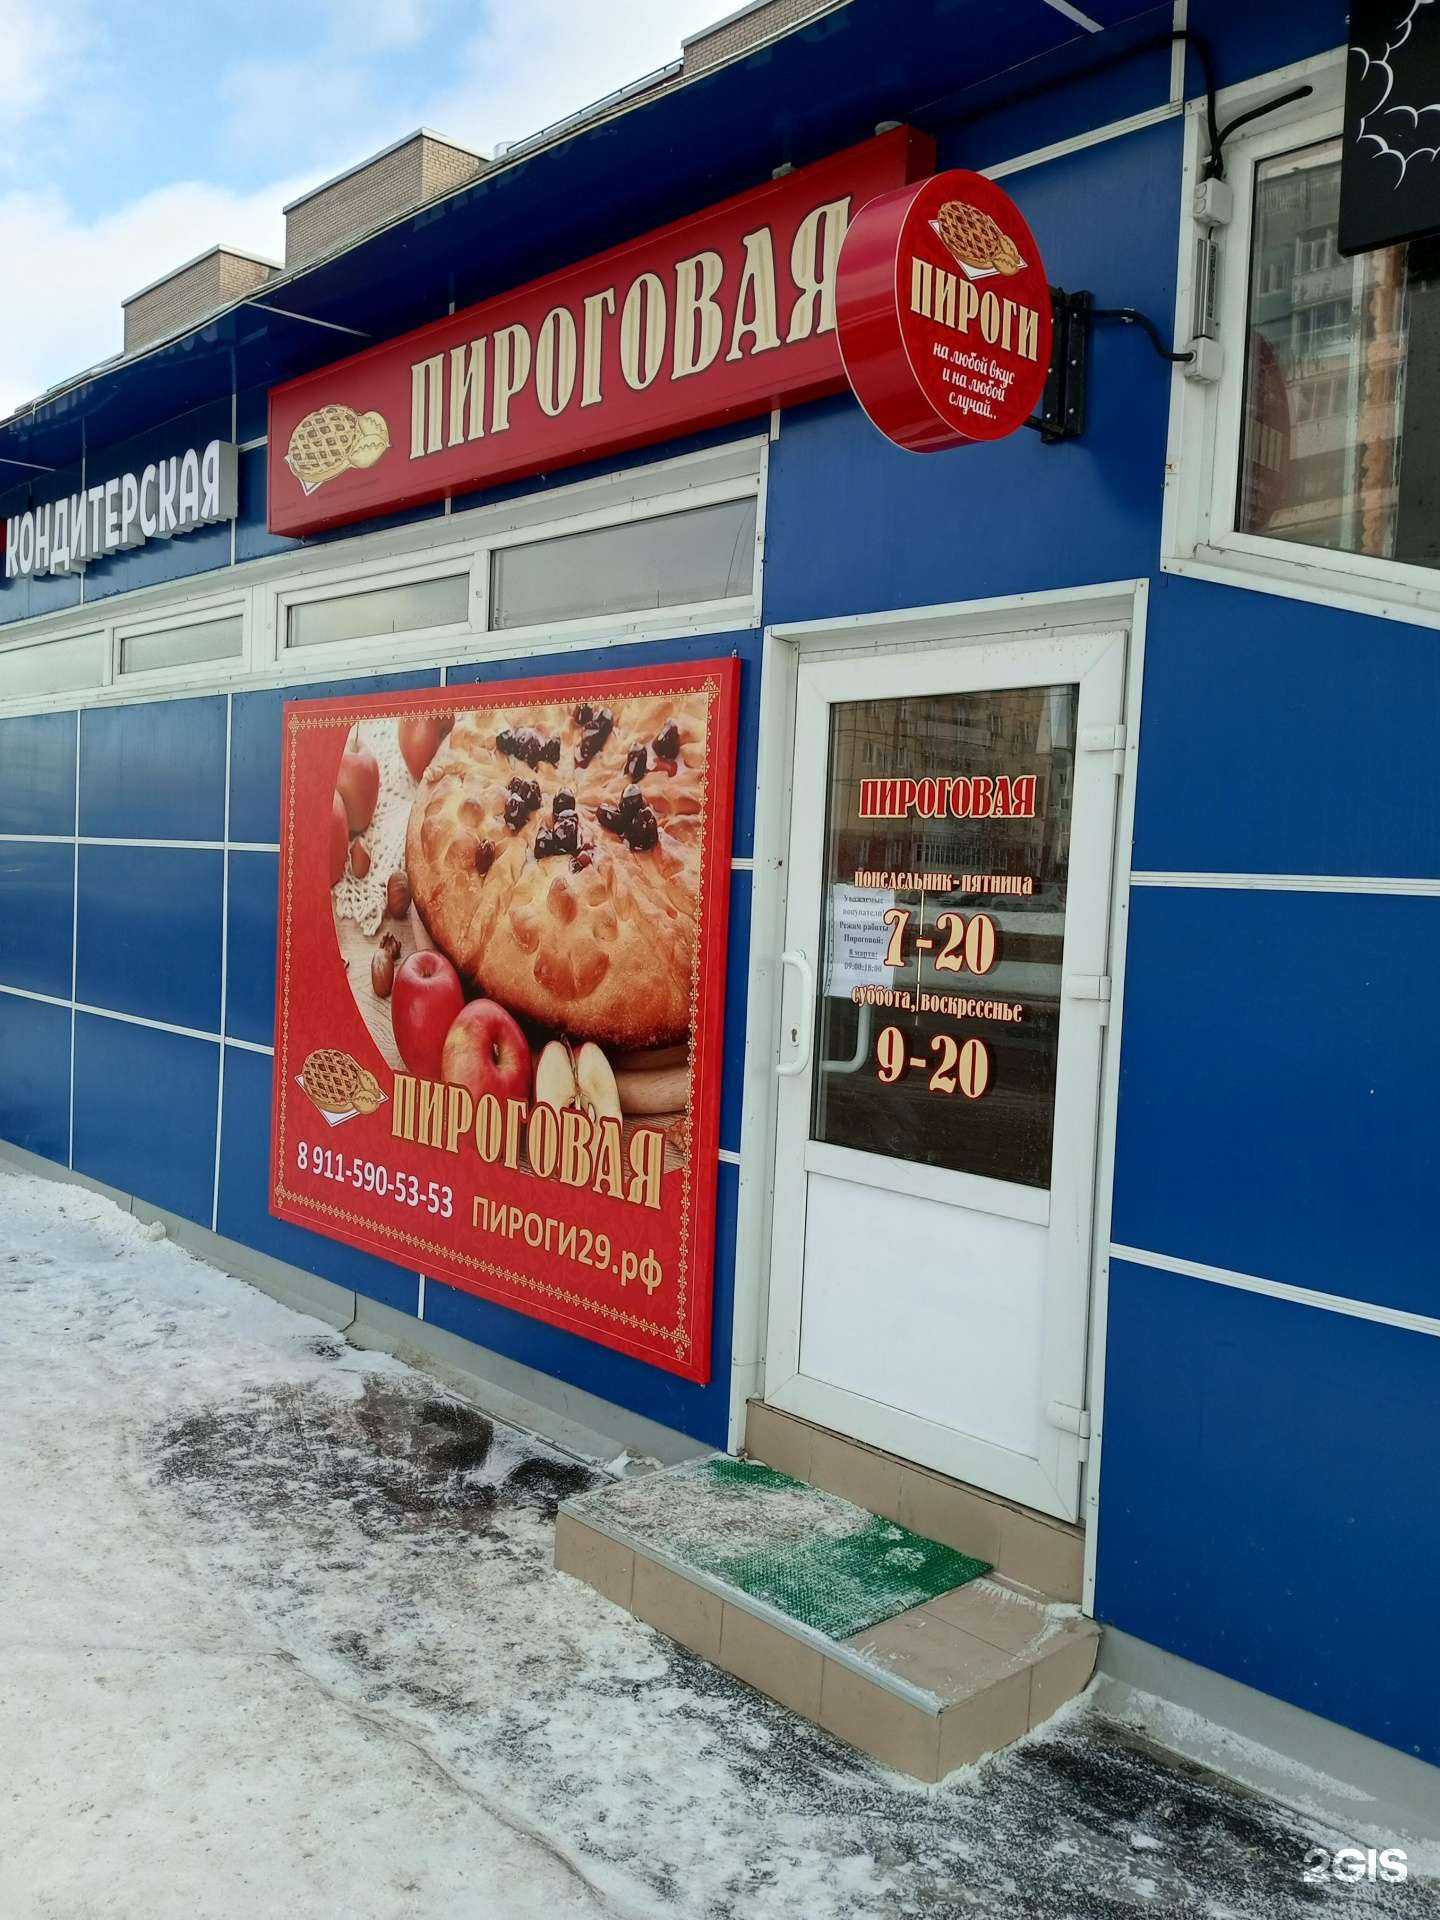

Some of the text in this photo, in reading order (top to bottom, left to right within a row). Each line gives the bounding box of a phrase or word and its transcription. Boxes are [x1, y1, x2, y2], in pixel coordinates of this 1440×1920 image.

[409, 196, 851, 460] ПИРОГОВАЯ
[910, 256, 1039, 361] ПИРОГИ
[933, 342, 1015, 388] на любой вкус
[942, 367, 1005, 402] и на любой
[6, 439, 221, 578] КОНДИТЕРСКАЯ
[859, 775, 1037, 818] ПИРОГОВАЯ
[851, 984, 1023, 1022] суббота, воскресенье
[297, 1141, 453, 1218] 8 911-590-53-53
[391, 1072, 667, 1209] ПИРОГОВАЯ
[472, 1195, 663, 1296] ПИРОГИ29.рф
